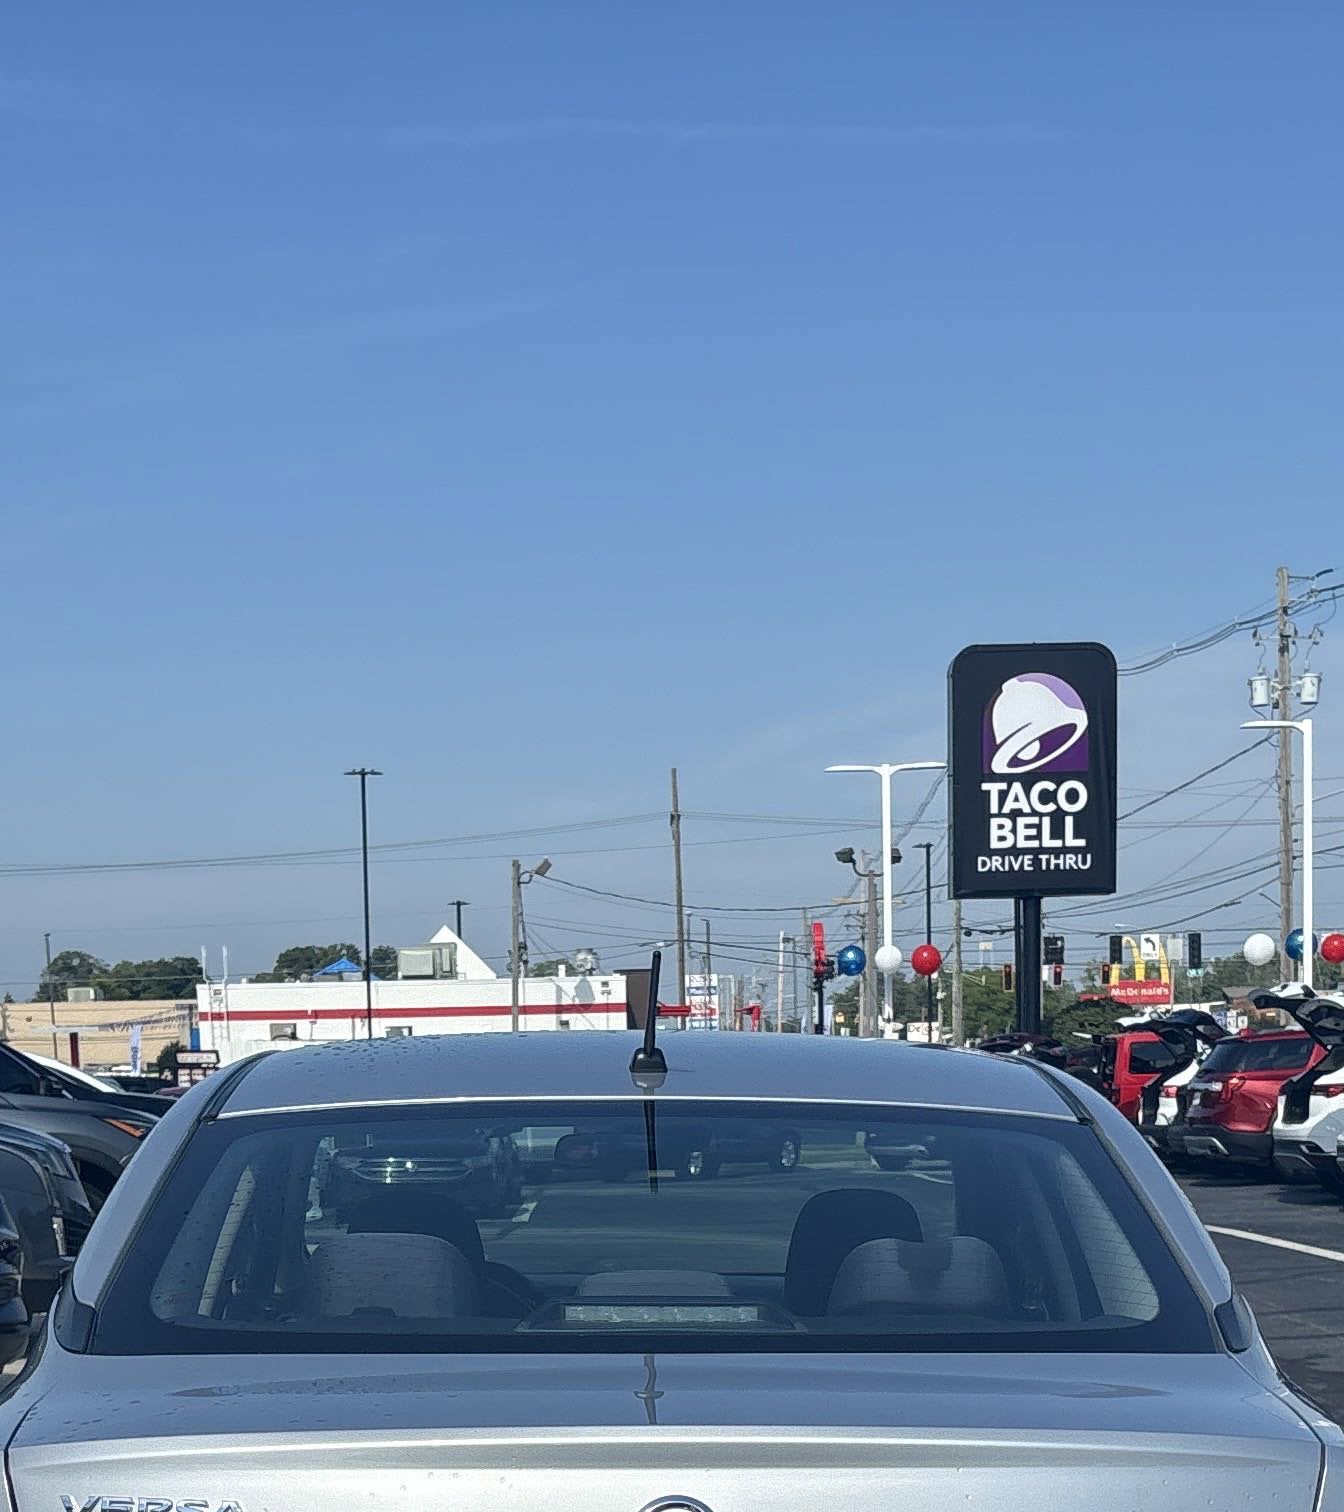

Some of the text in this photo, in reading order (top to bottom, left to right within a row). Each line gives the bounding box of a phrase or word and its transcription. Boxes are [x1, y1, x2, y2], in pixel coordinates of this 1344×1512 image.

[981, 780, 1088, 814] TACO
[989, 817, 1087, 850] BELL
[977, 853, 1092, 872] DRIVE THRU
